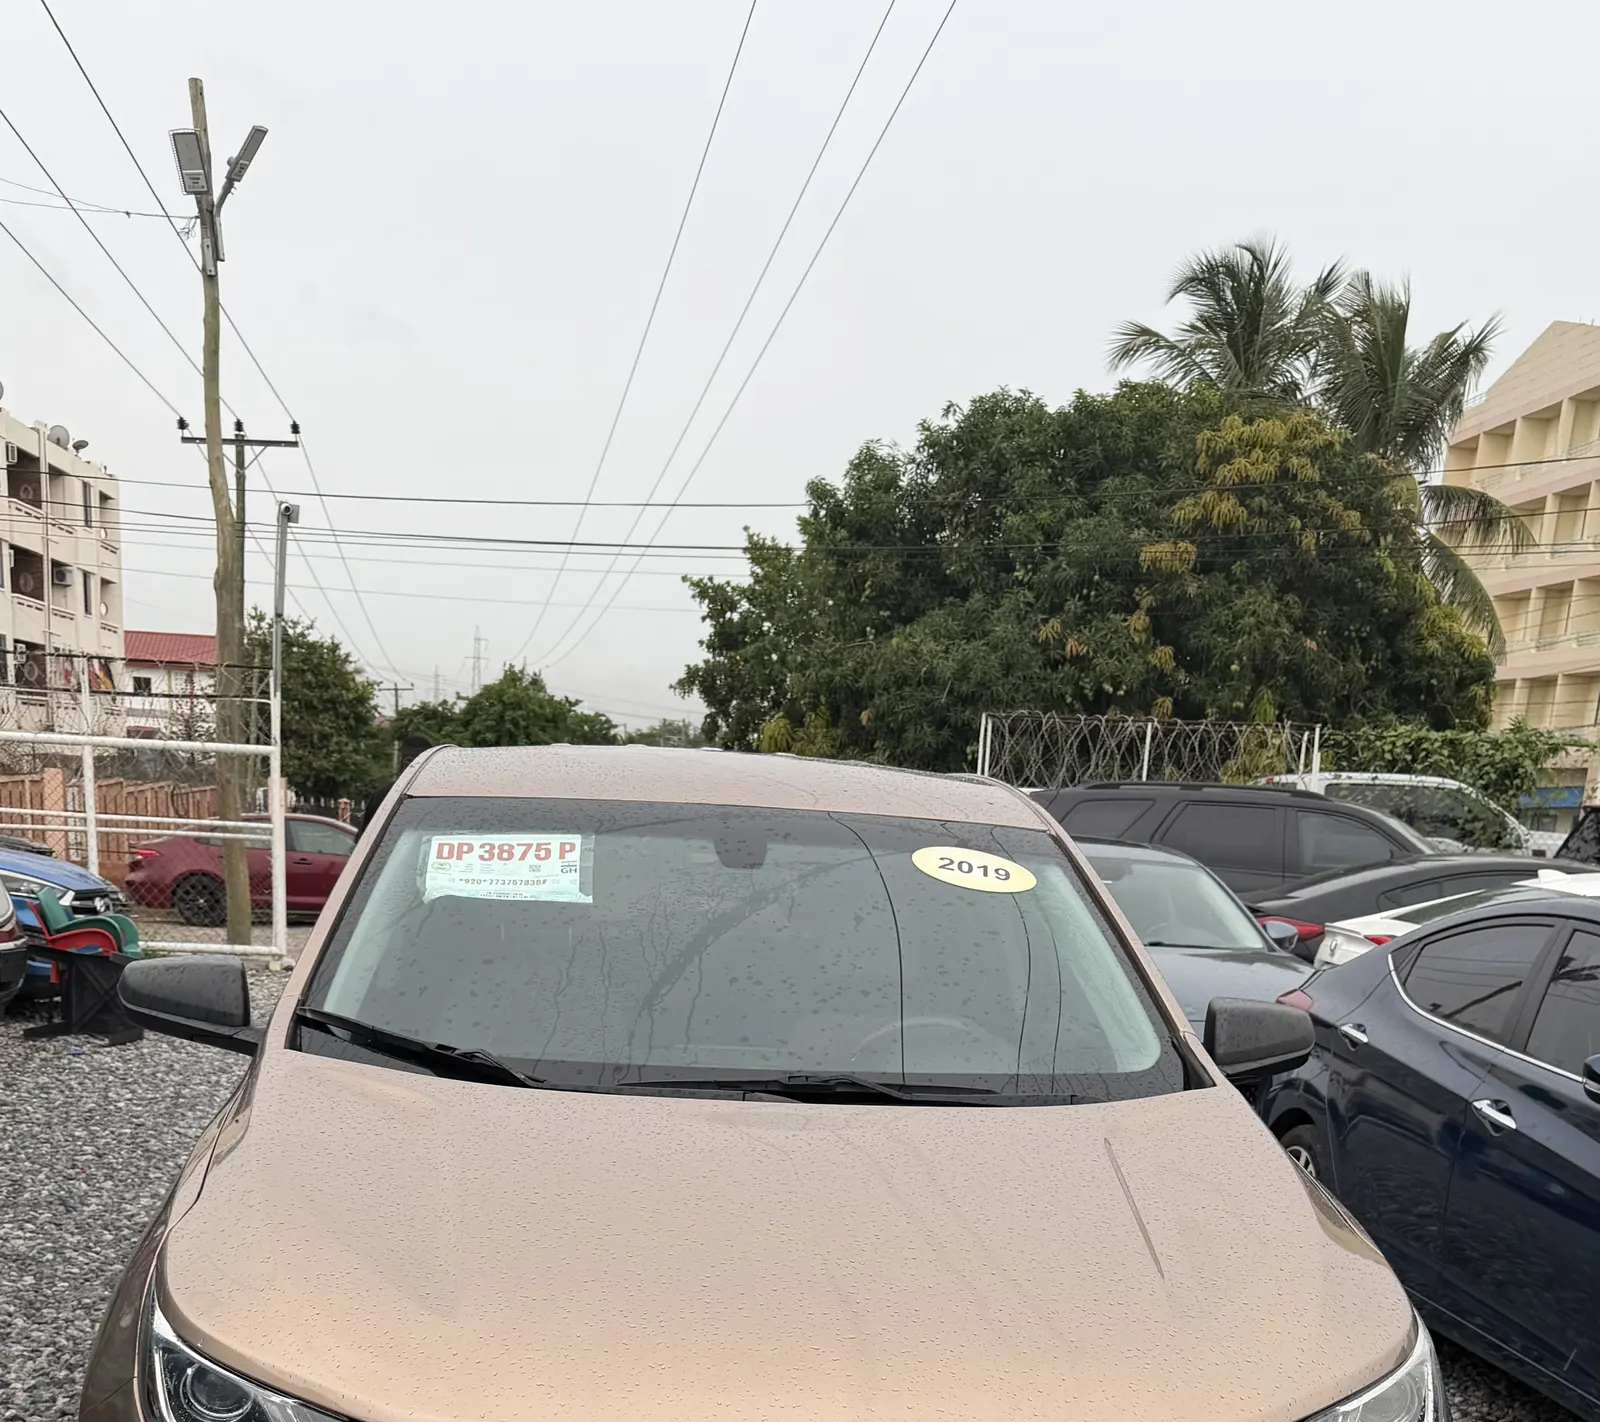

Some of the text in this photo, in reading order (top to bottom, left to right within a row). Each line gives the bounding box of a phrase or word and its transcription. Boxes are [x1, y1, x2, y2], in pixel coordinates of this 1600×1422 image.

[436, 842, 576, 861] DP 3875 P
[938, 857, 1011, 881] 2019
